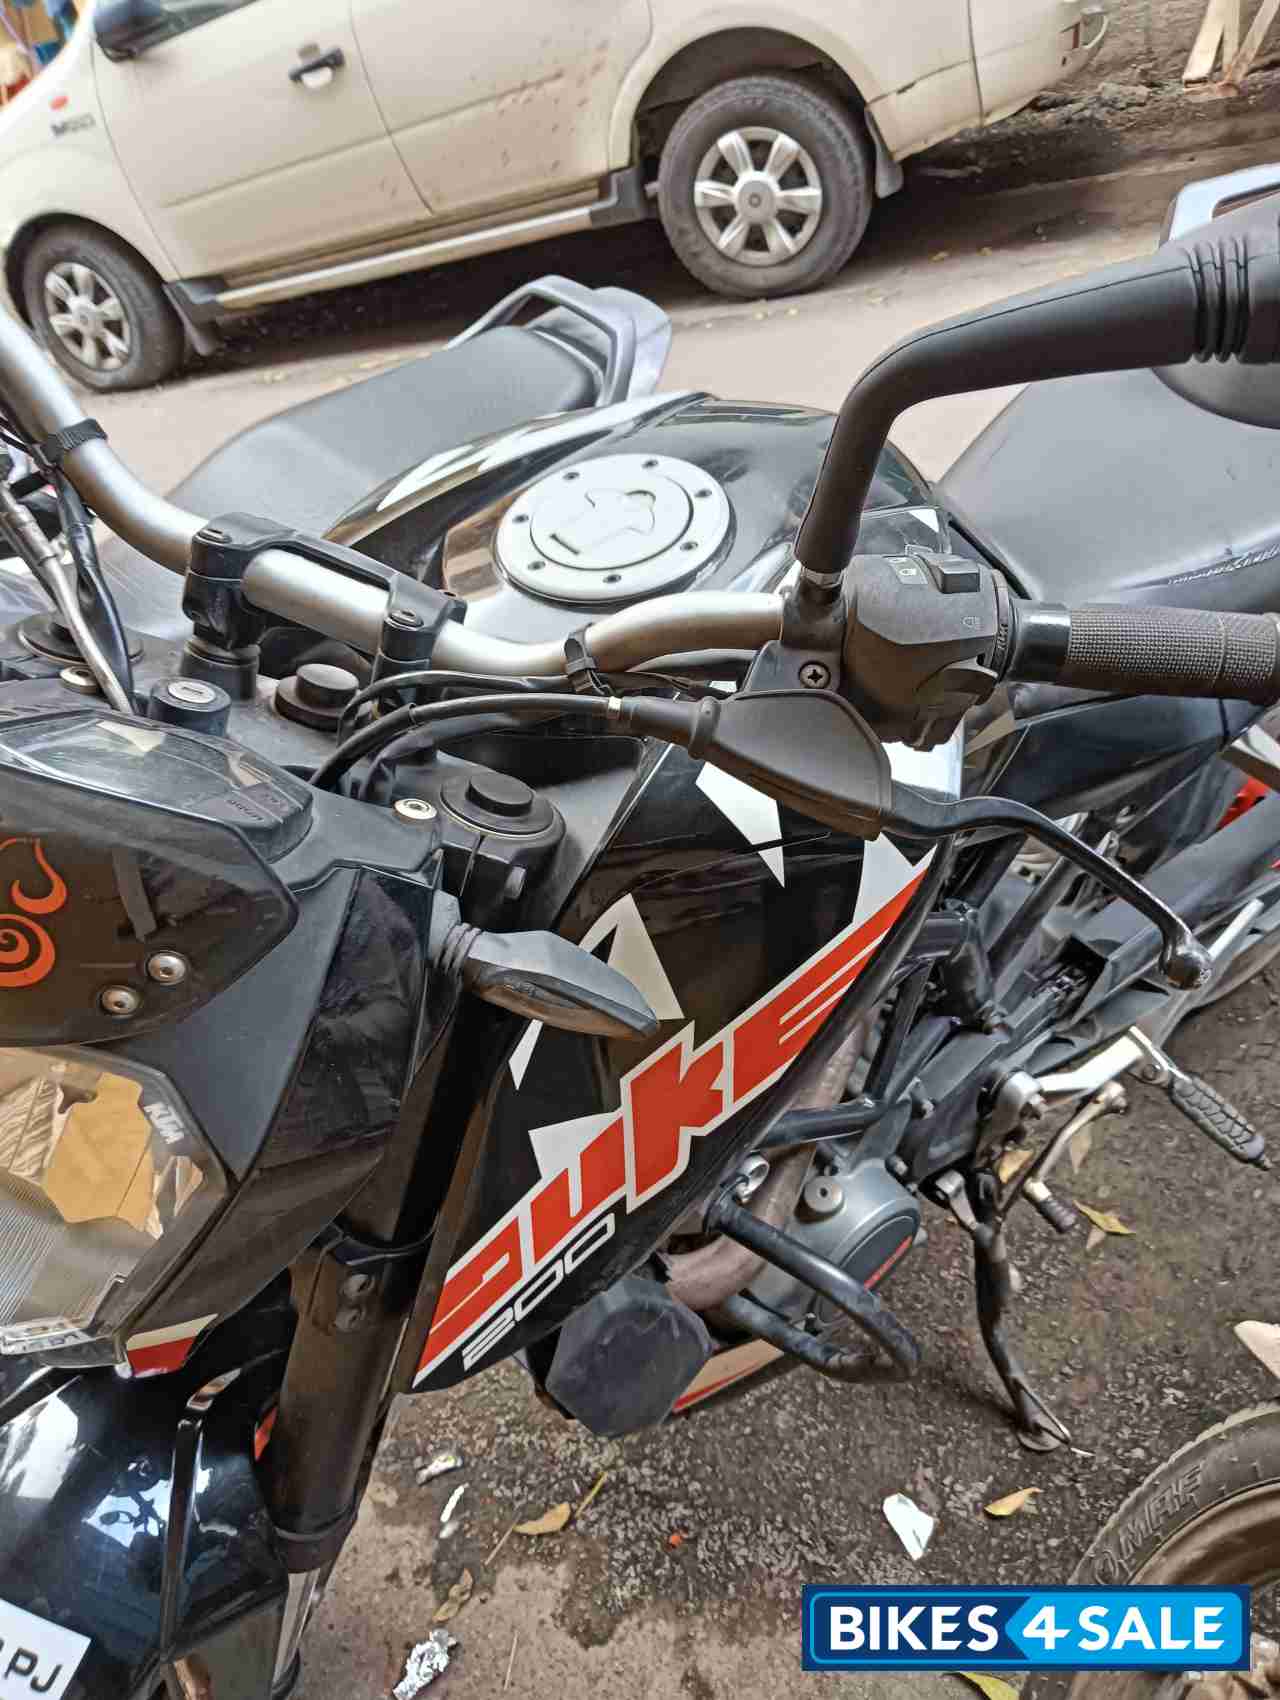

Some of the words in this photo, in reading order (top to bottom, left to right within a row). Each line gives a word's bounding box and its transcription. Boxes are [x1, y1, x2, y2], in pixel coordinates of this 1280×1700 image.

[144, 1102, 184, 1144] KTM
[412, 845, 938, 1388] DUKE
[462, 1213, 615, 1371] 200
[1119, 1463, 1203, 1560] MRF
